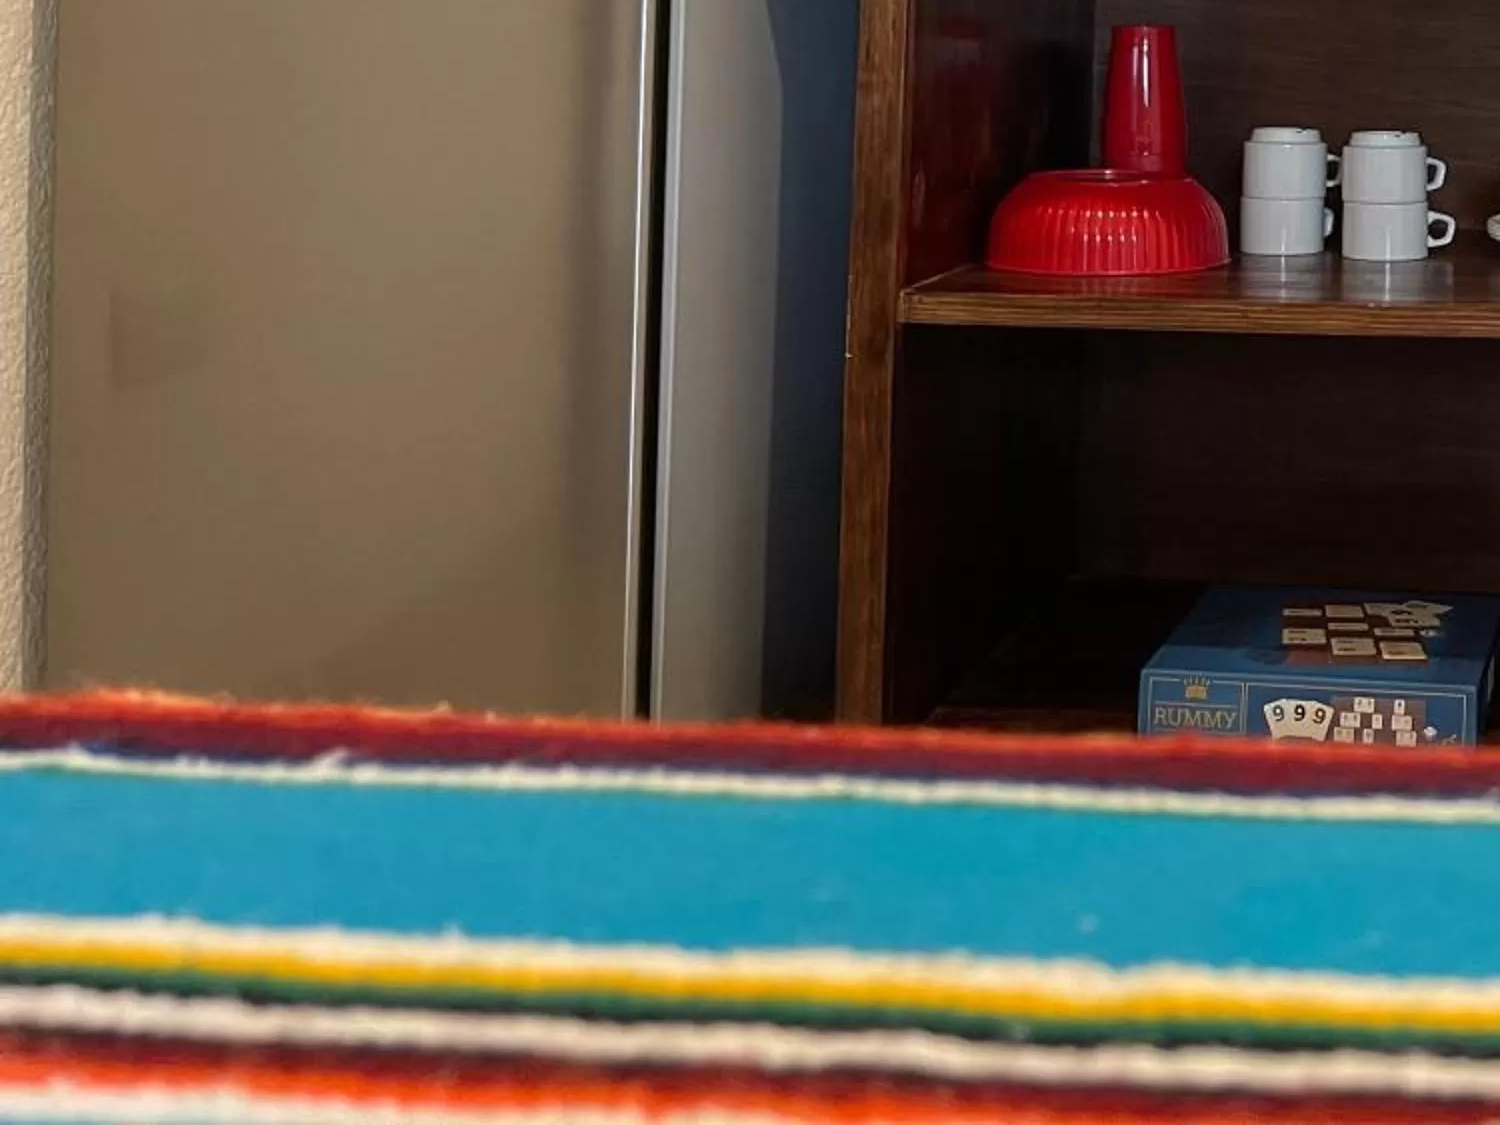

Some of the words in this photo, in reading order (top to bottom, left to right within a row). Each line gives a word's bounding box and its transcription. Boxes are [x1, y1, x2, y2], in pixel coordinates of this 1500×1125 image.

[1153, 706, 1238, 730] RUMMY
[1272, 704, 1285, 722] 9
[1293, 704, 1306, 722] 9
[1312, 707, 1327, 724] 9
